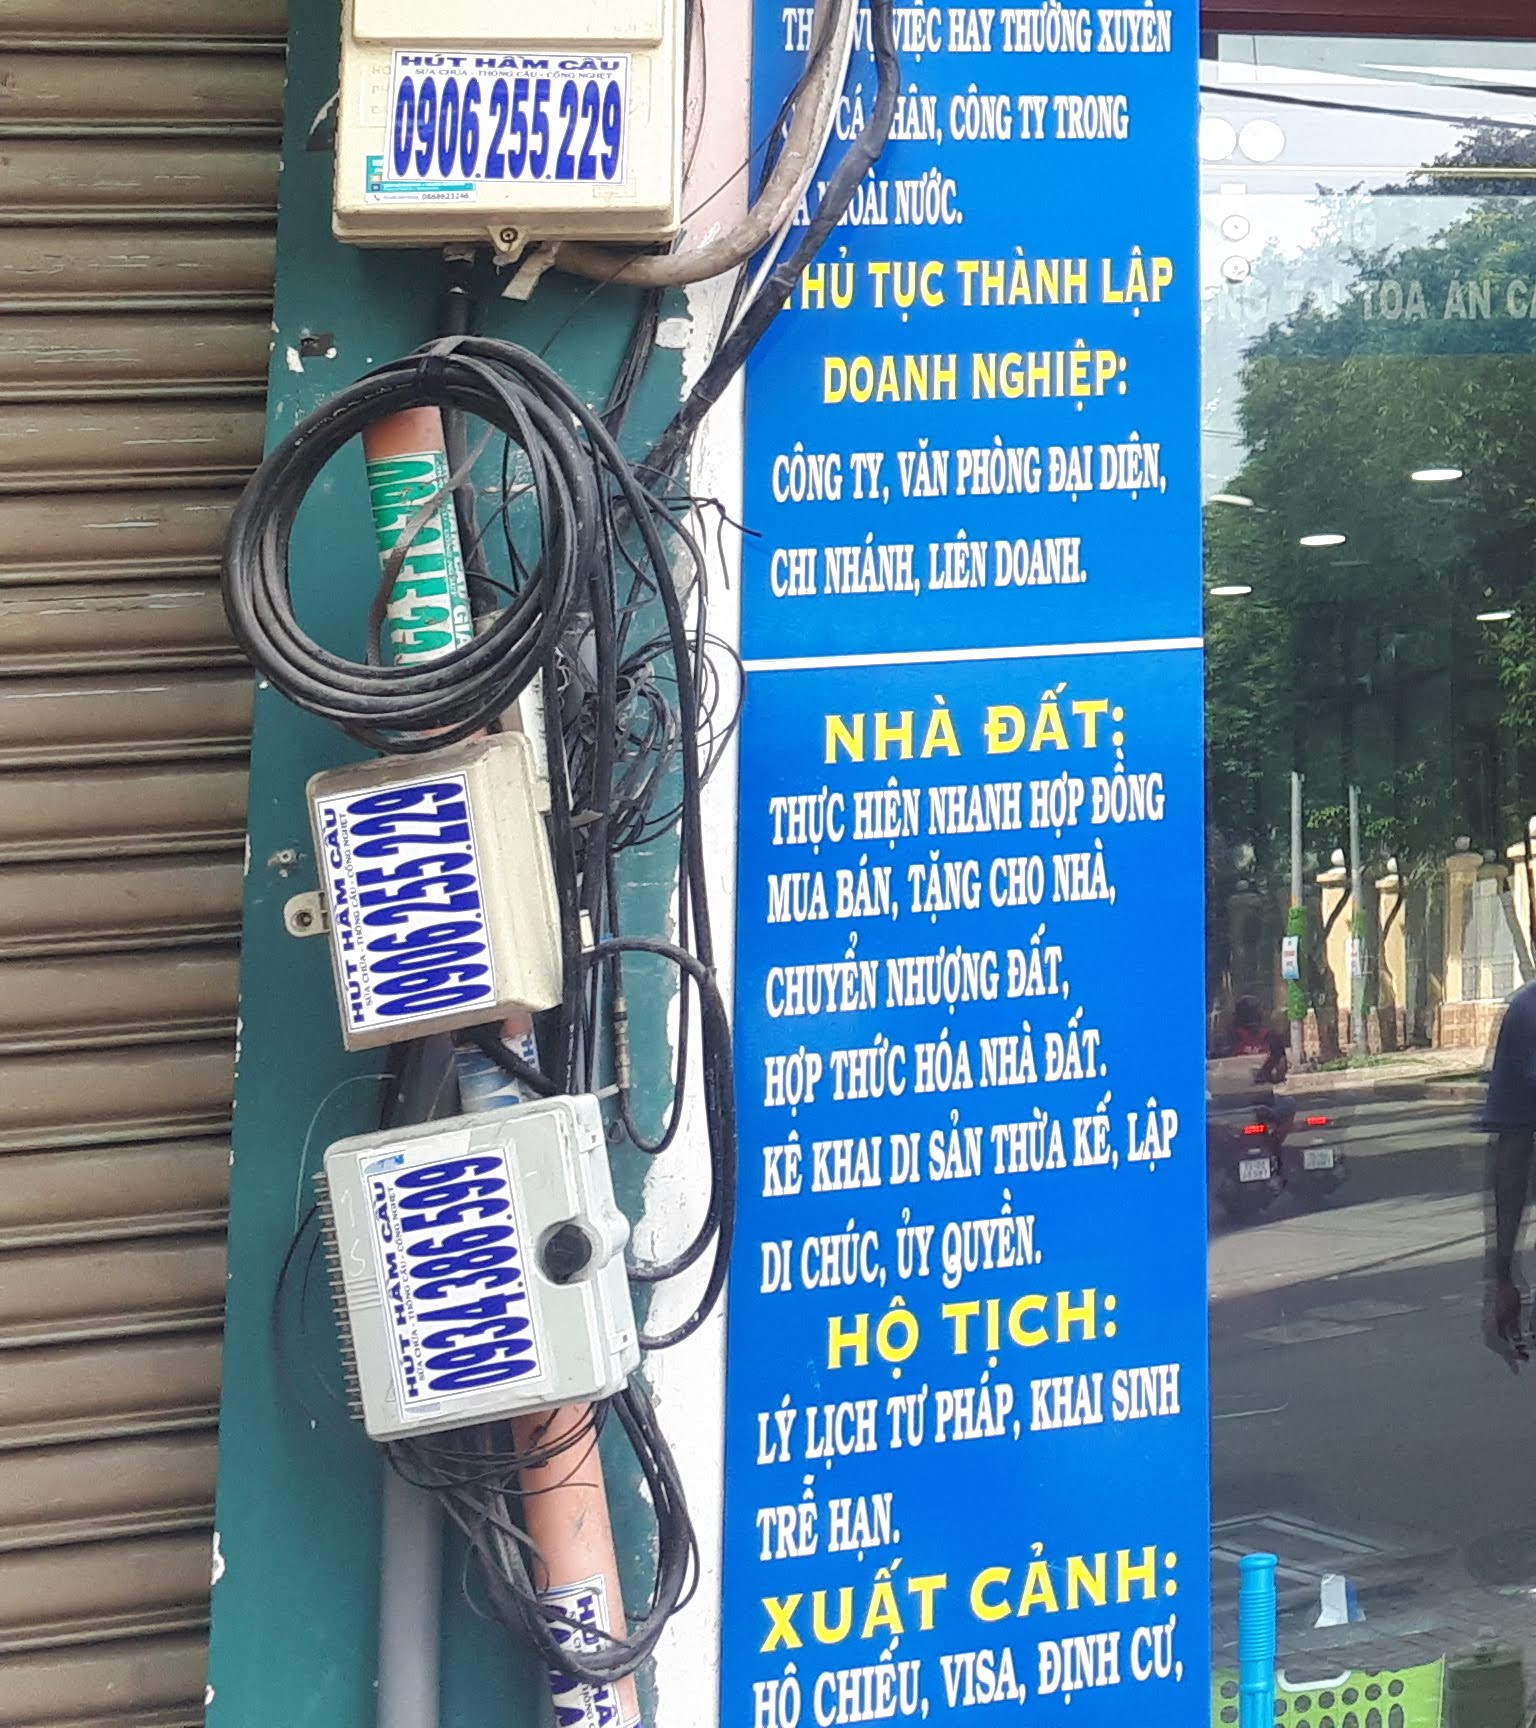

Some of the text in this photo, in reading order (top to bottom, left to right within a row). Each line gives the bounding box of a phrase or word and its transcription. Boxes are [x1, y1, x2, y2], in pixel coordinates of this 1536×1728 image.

[401, 54, 620, 71] HÚT HẦM CẦU
[947, 8, 996, 52] HAY
[393, 75, 622, 180] 0906.255.229
[949, 83, 1129, 141] CÔNG TY TRONG
[894, 166, 963, 226] NƯỚC.
[867, 245, 1173, 323] TỤC THÀNH LẬP
[823, 338, 1127, 412] DOANH NGHIỆP:
[772, 431, 1166, 504] CÔNG TY, VĂN PHÒNG ĐẠI DIỆN,
[770, 528, 1087, 598] CHI NHÁNH, LIÊN DOANH.
[824, 682, 1124, 764] NHÀ ĐẤT:
[769, 747, 1165, 855] THỰC HIỆN NHANH HỢP ĐỒNG
[322, 808, 364, 1023] HÚT HẦM CẦU
[346, 783, 491, 1016] 0906.255.229
[767, 837, 1116, 924] MUA BÁN, TẶNG CHO NHÀ,
[765, 923, 1069, 1018] CHUYỂN NHƯỢNG ĐẤT,
[763, 1006, 1107, 1117] HỢP THỨC HÓA NHÀ ĐẤT.
[762, 1090, 1178, 1197] KÊ KHAI DI SẢN THỪA KẾ, LẬP
[394, 1156, 537, 1391] 0934.386.599
[760, 1188, 1042, 1294] DI CHÚC, ỦY QUYỀN.
[373, 1181, 419, 1397] HÚT HẦM CẦU
[827, 1288, 1117, 1380] HỘ TỊCH:
[756, 1363, 1180, 1470] LÝ LỊCH TƯ PHÁP, KHAI SINH
[828, 1493, 900, 1562] HẠN.
[760, 1542, 1178, 1653] XUẤT CẢNH:
[813, 1635, 929, 1728] CHIẾU,
[939, 1647, 1026, 1708] VISA,
[1037, 1631, 1121, 1705] ĐỊNH
[1130, 1614, 1183, 1682] CƯ,
